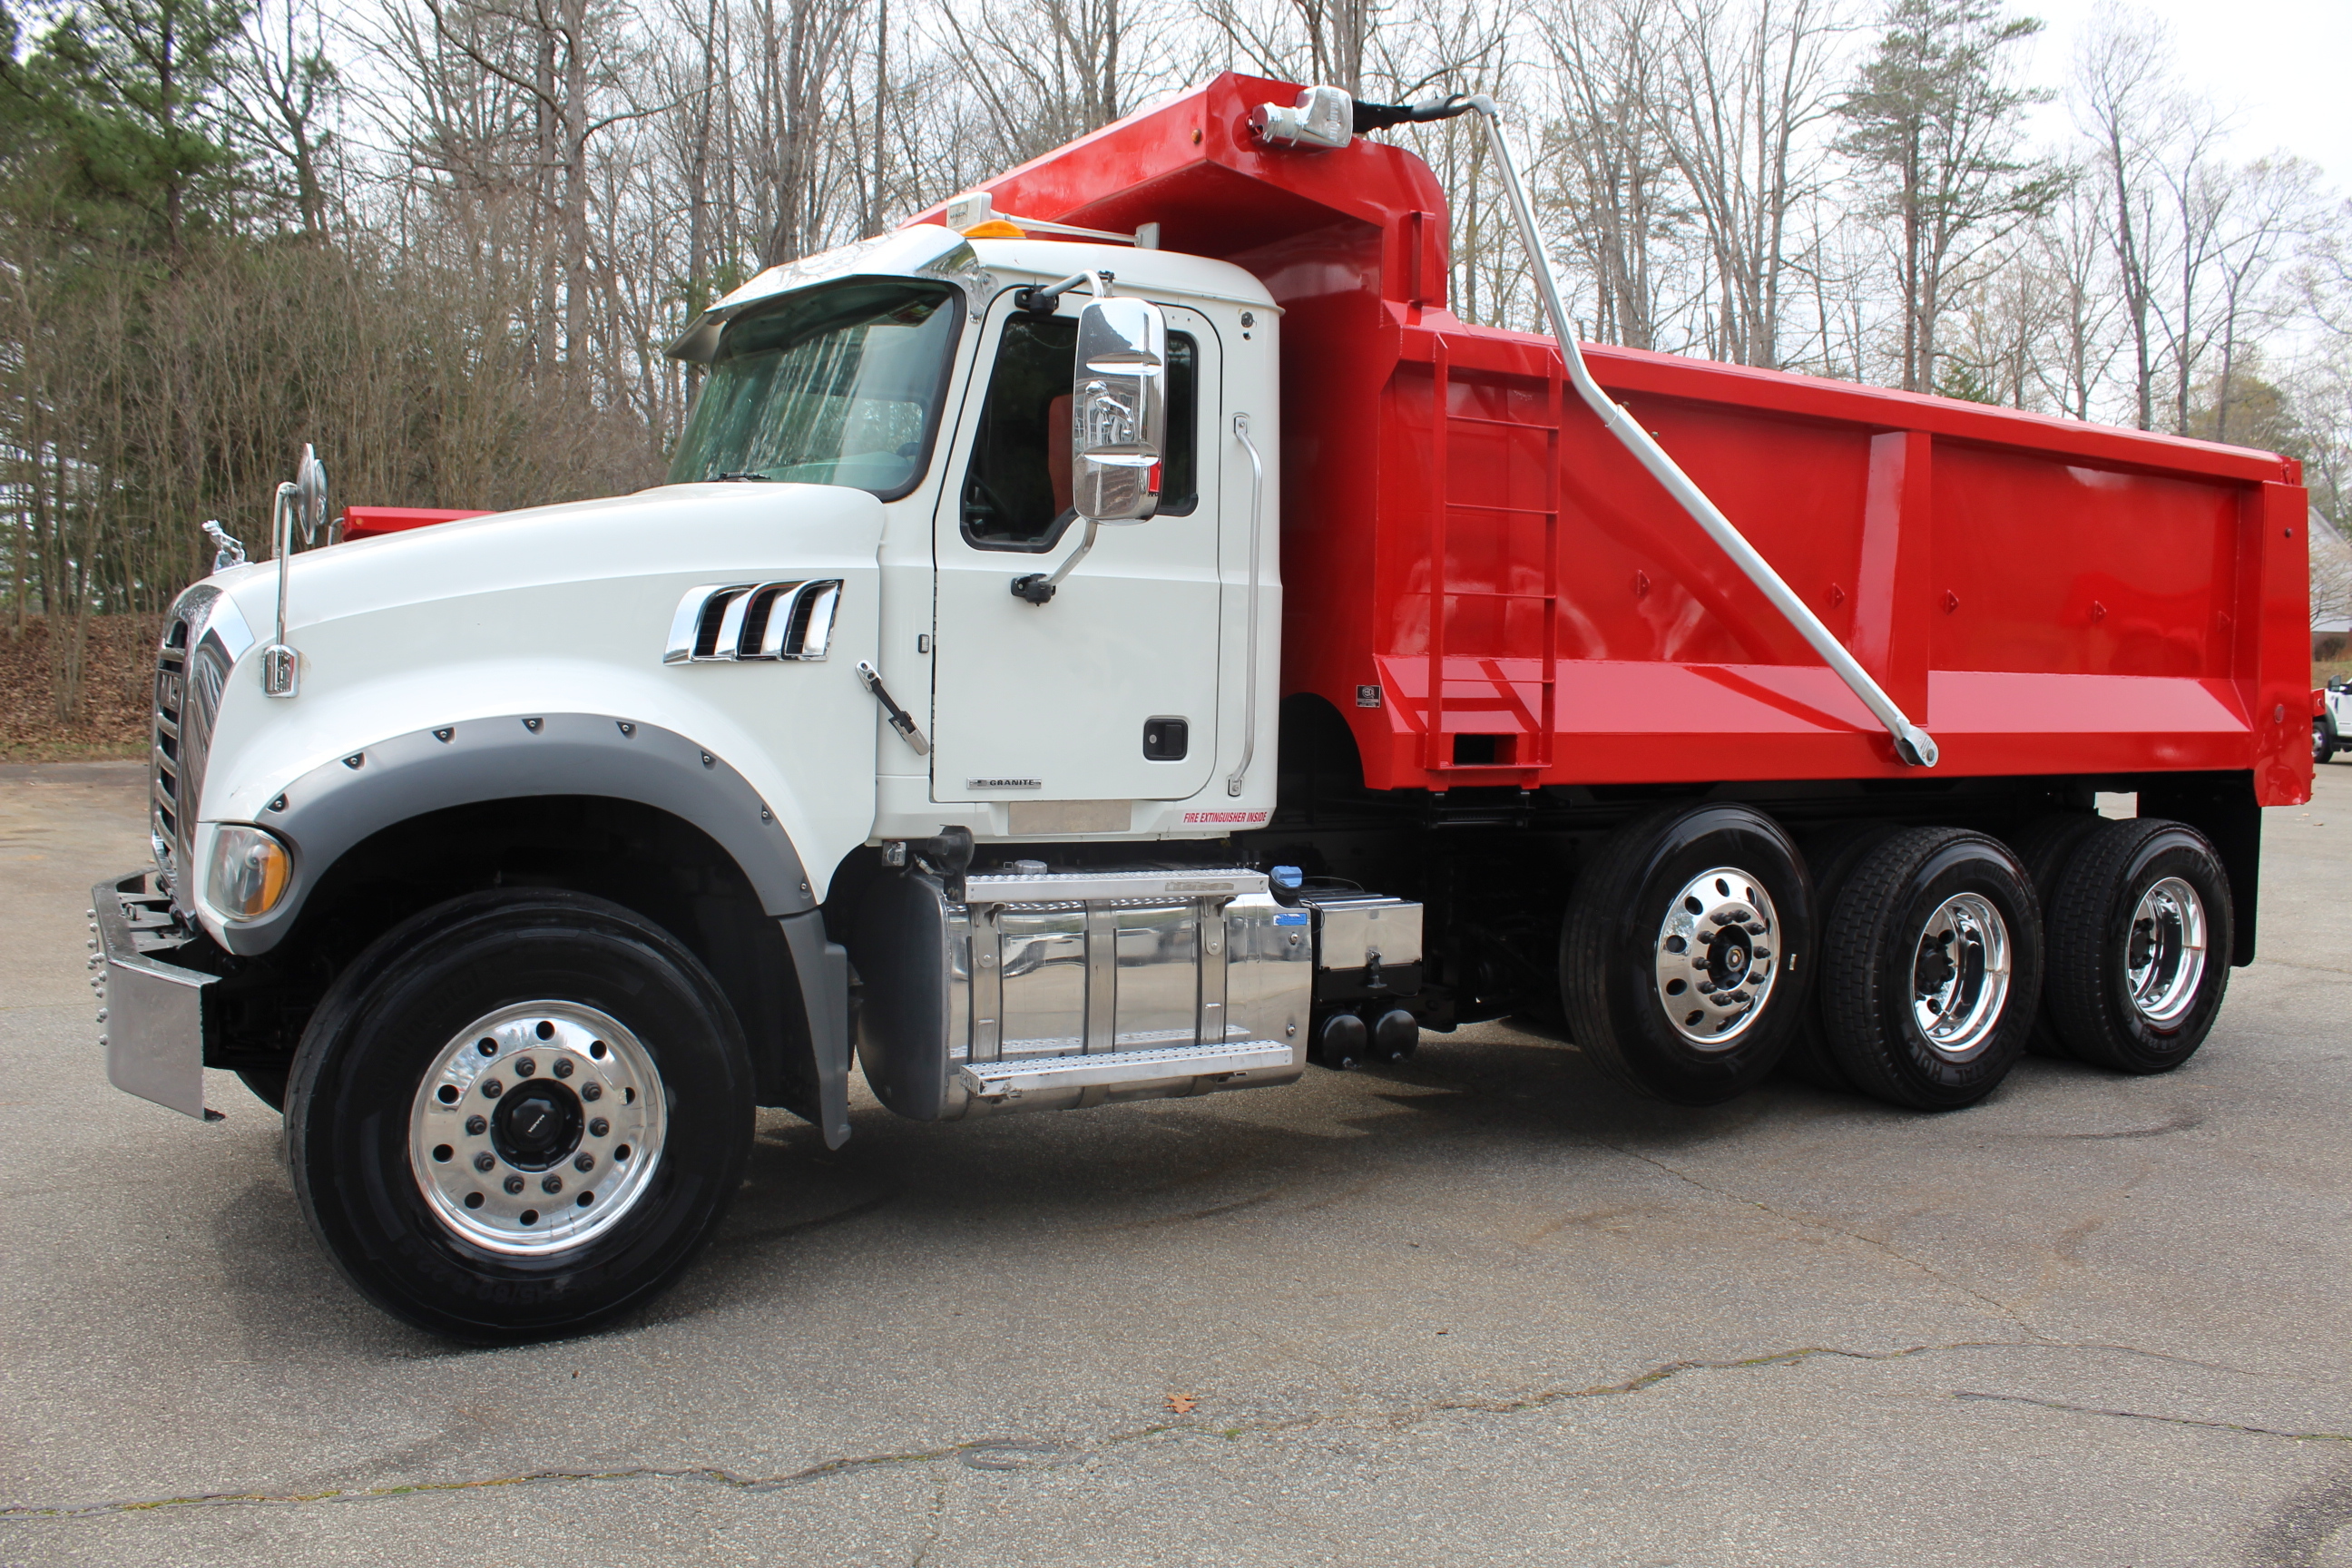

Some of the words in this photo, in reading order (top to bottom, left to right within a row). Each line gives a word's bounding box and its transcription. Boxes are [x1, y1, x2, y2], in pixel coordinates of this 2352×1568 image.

[950, 211, 966, 220] MACK
[1183, 812, 1200, 823] FIRE
[1200, 811, 1247, 823] EXTINGUISHER
[1247, 811, 1268, 822] INSIDE
[1975, 858, 2029, 919] Continental
[527, 1113, 545, 1132] MACK
